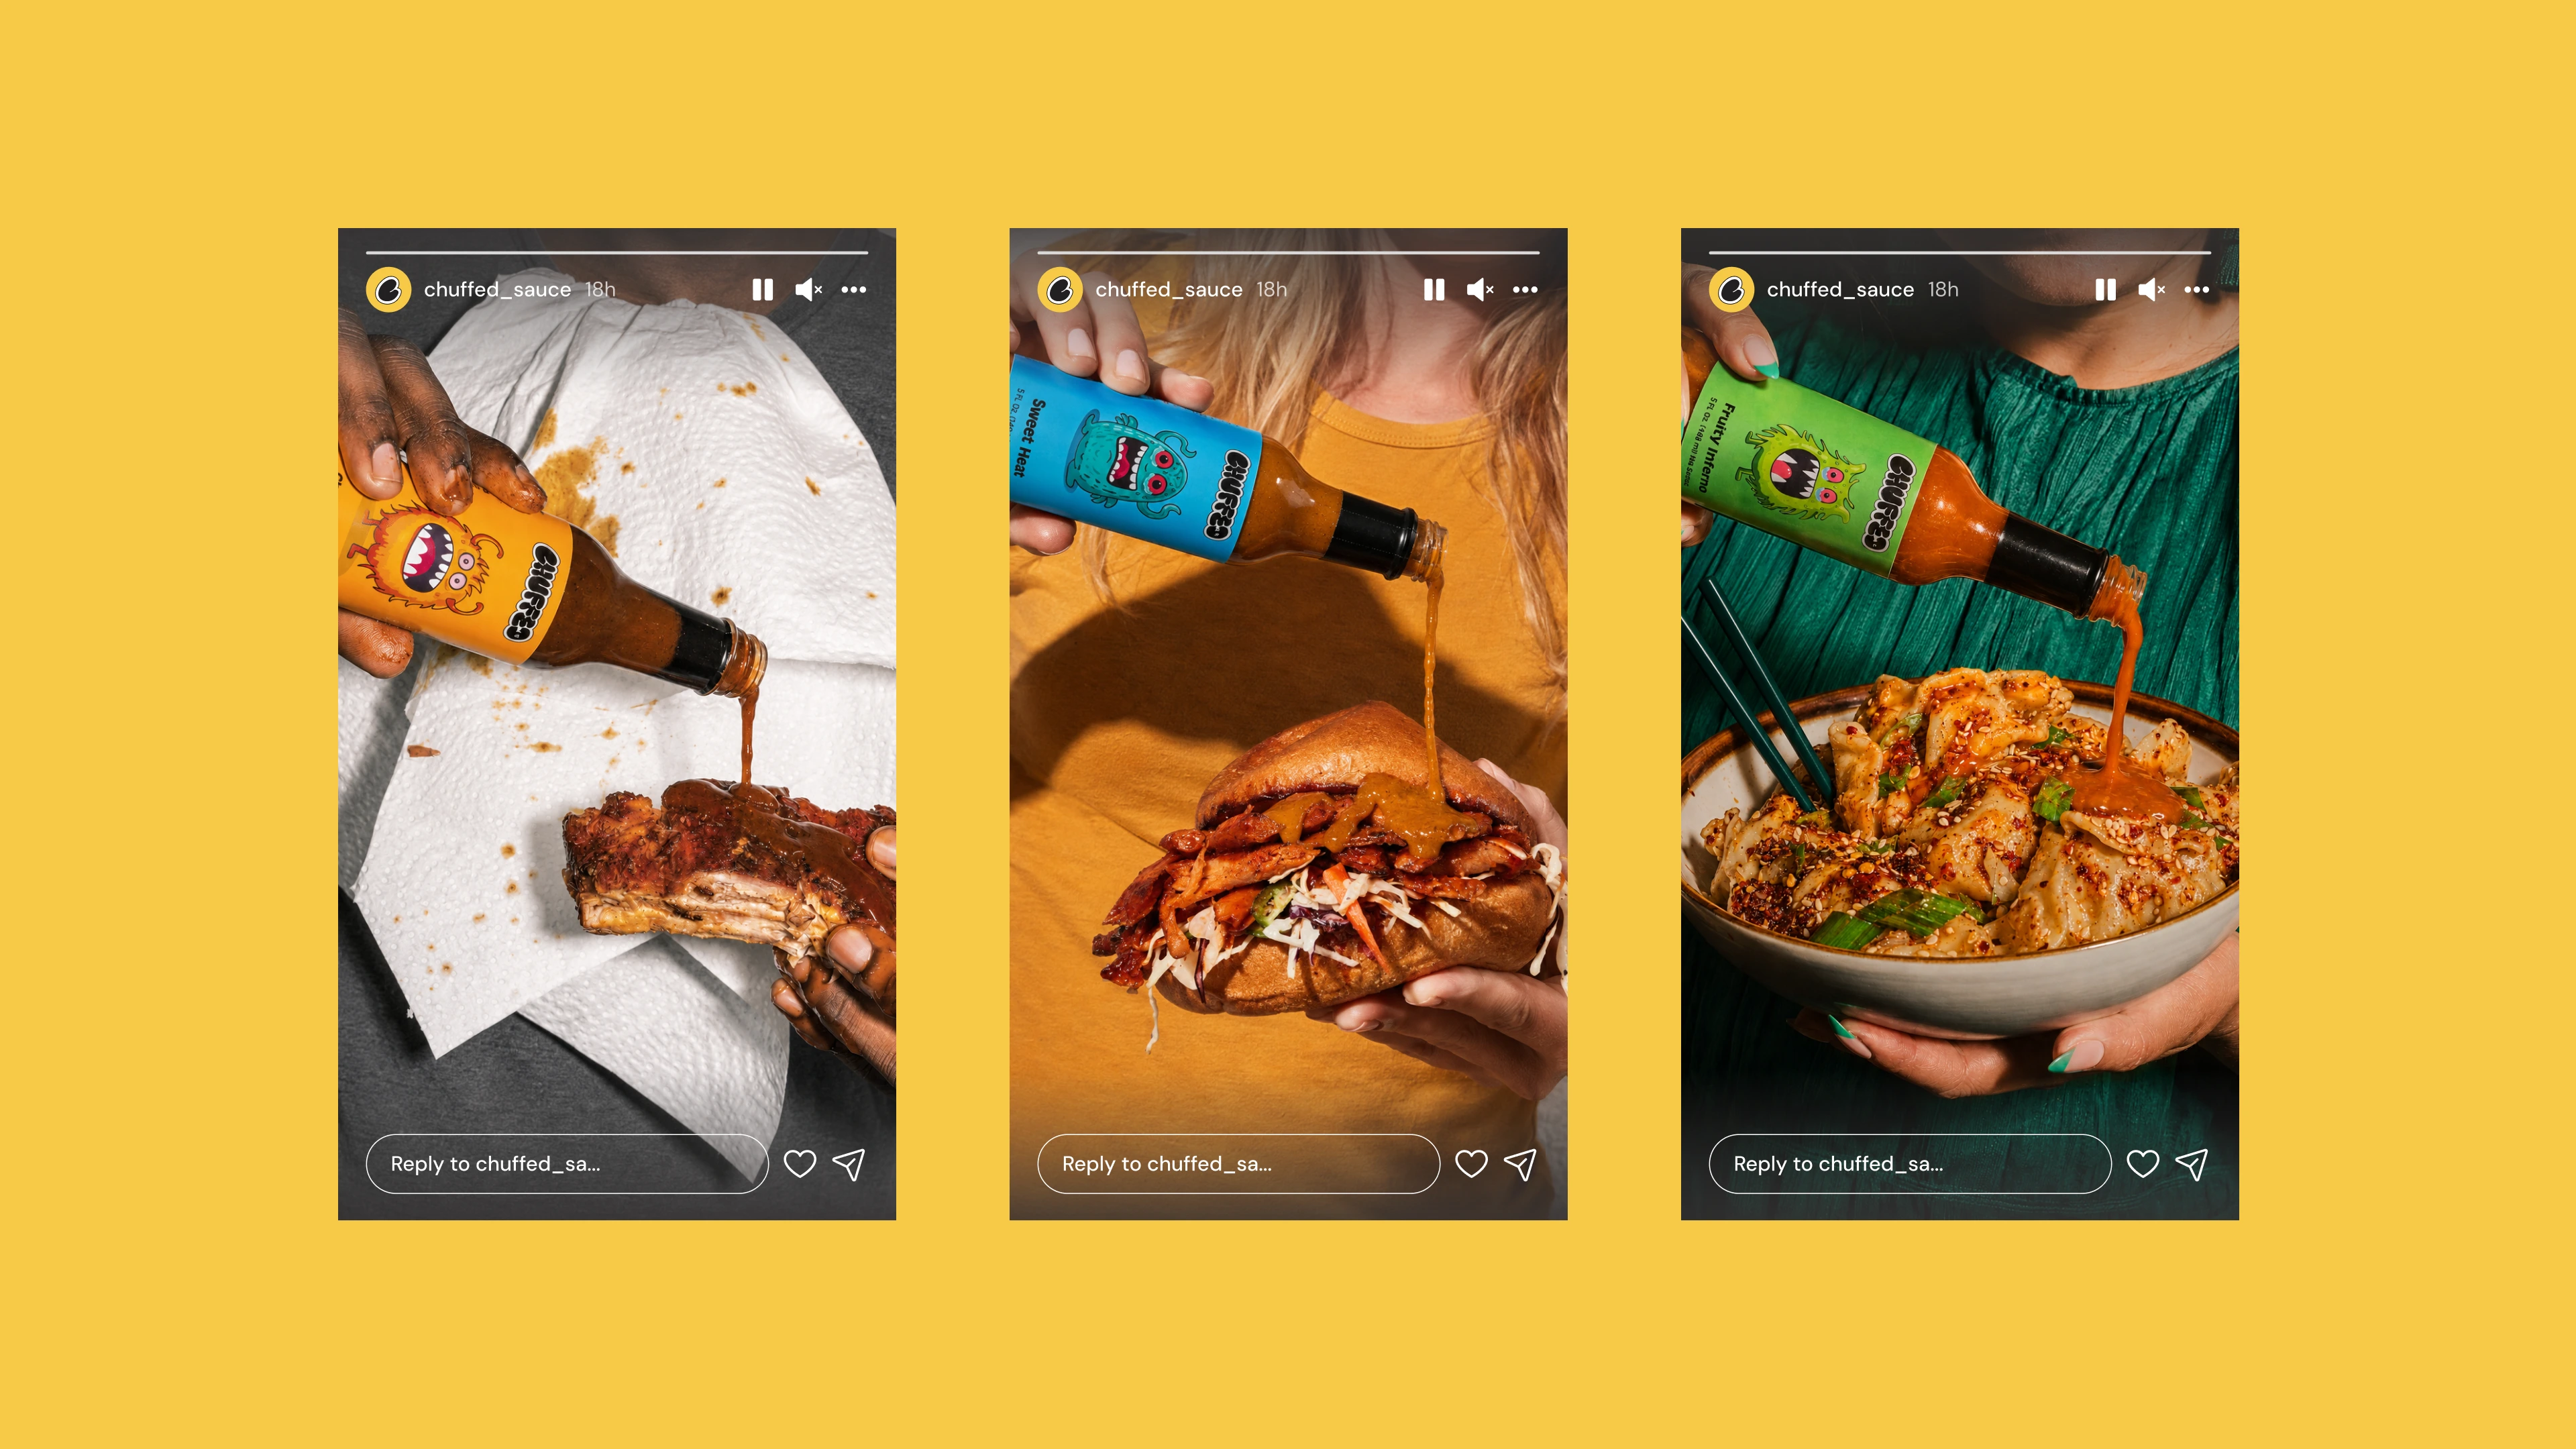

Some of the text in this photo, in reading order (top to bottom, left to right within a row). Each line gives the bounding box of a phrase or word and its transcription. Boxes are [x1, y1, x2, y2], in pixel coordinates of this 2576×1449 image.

[1014, 394, 1024, 402] FL
[1014, 398, 1046, 478] Sweet Heat
[1702, 412, 1711, 422] Oz
[1707, 402, 1715, 411] FL
[1699, 402, 1736, 494] Fruity Inferno
[1203, 449, 1252, 541] CHUFFED
[1861, 453, 1917, 553] CHUFFED
[502, 542, 561, 643] CHUFFED
